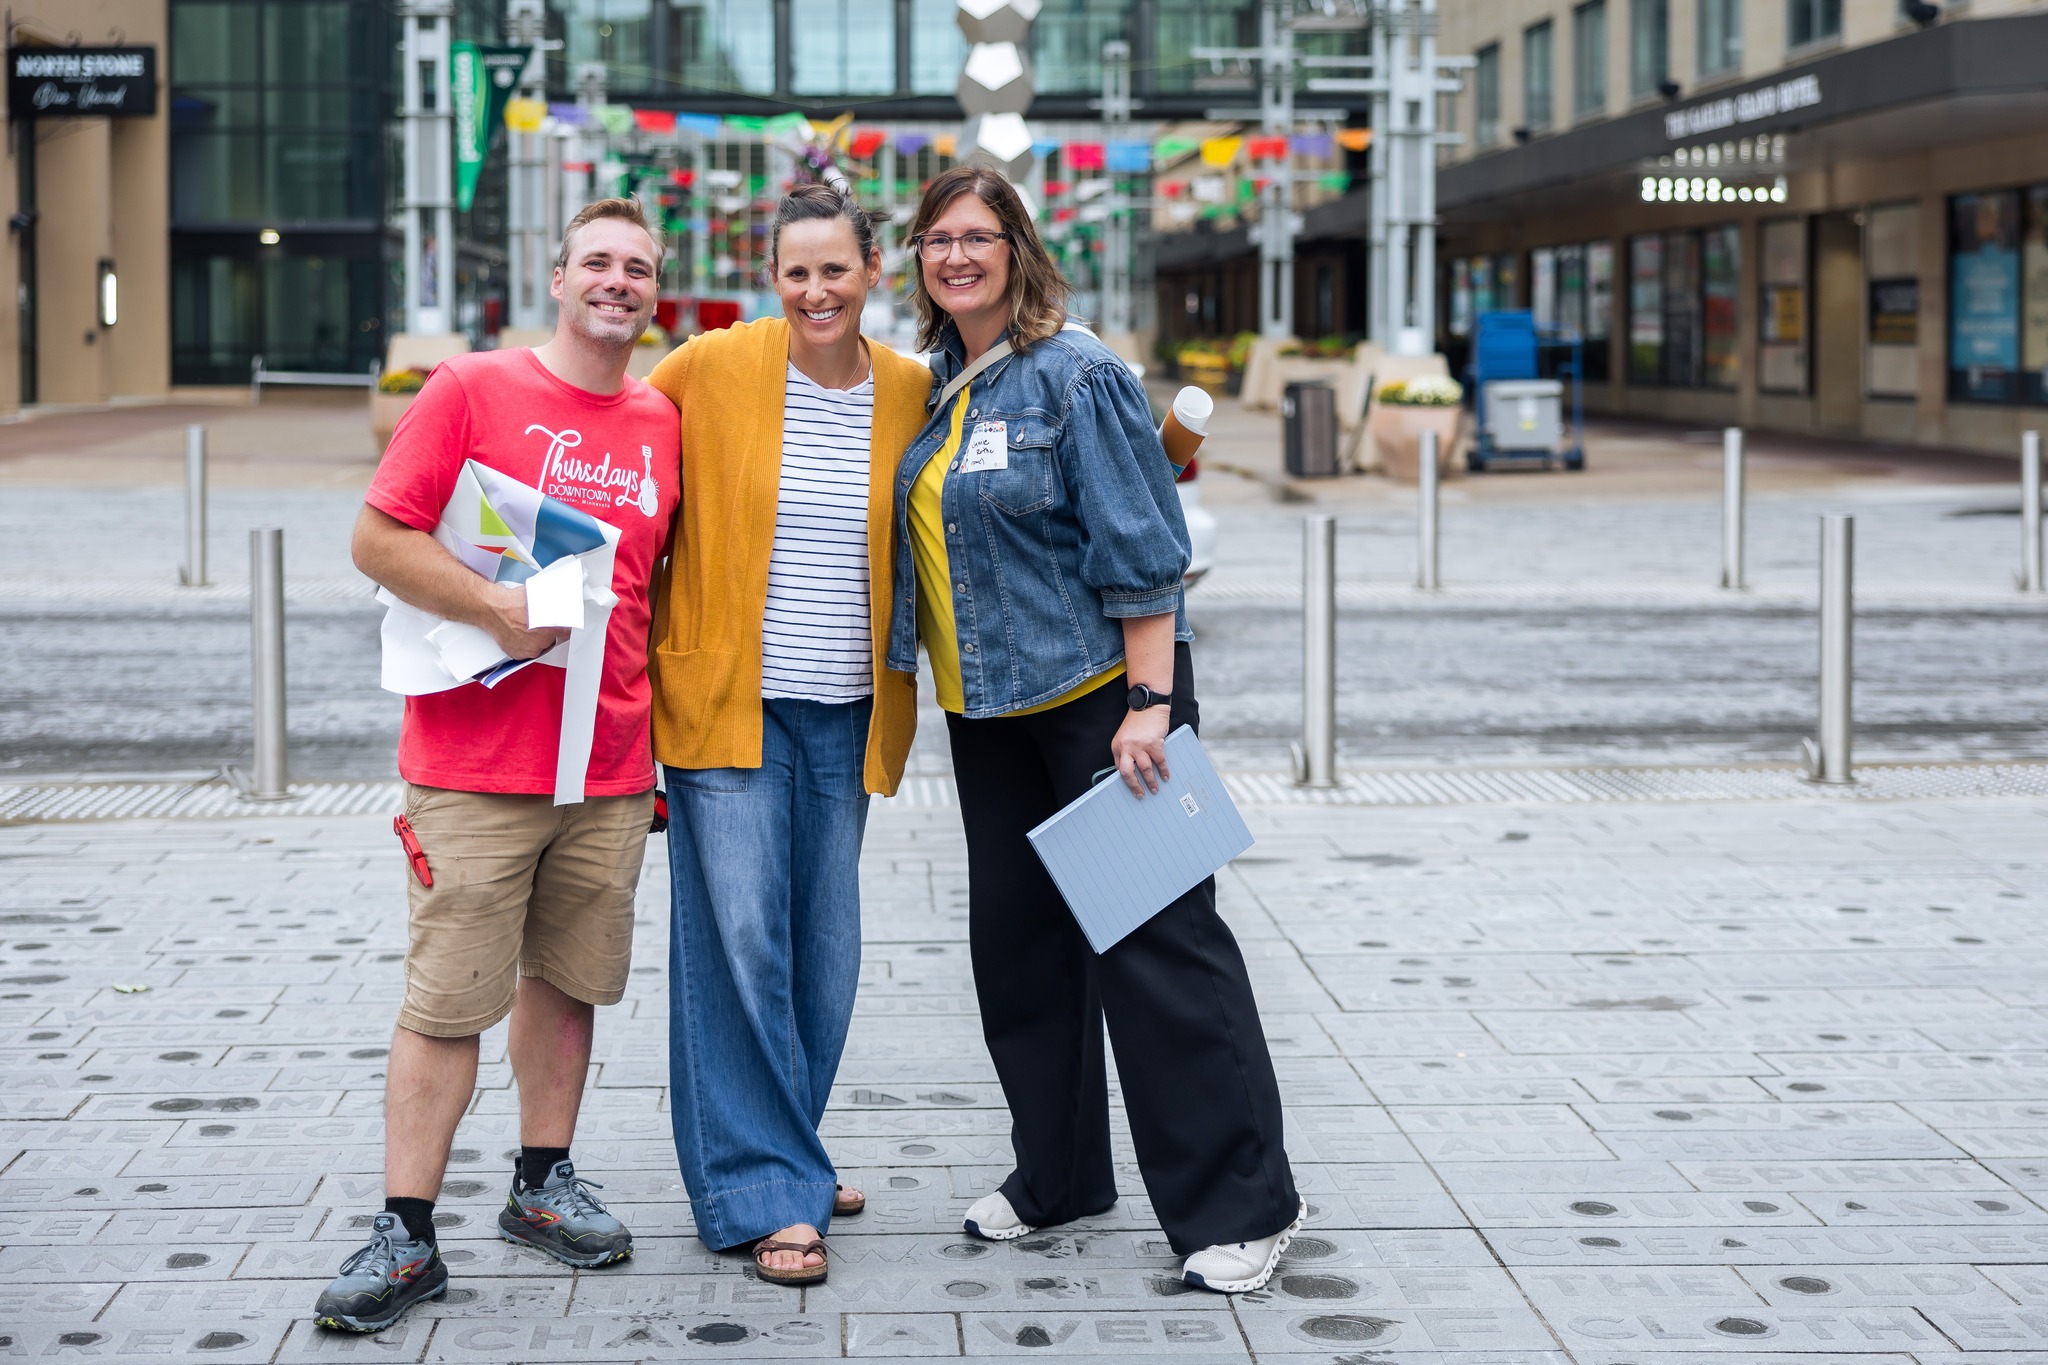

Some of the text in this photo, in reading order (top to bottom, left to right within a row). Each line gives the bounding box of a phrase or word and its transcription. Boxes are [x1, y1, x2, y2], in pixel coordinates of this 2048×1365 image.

[525, 424, 640, 507] Thursdays
[548, 483, 612, 503] DOWNTOWN
[98, 1027, 390, 1043] CULTUR
[1383, 1082, 1574, 1100] TIME
[2, 1126, 160, 1143] THE
[1404, 1109, 1567, 1126] THE
[21, 1154, 116, 1173] IN
[1438, 1136, 1595, 1155] ALL
[1615, 1134, 1942, 1154] THINGS
[0, 1179, 303, 1205] EARTH
[1702, 1165, 1972, 1185] SPIRIT
[125, 1212, 304, 1237] THE
[1472, 1197, 1793, 1220] LIQUID
[1835, 1196, 2026, 1219] AND
[0, 1249, 222, 1274] AND
[598, 1281, 784, 1306] THE
[1270, 1268, 1473, 1306] OF
[1529, 1273, 1736, 1298] THE
[1768, 1272, 1978, 1298] OLD
[453, 1320, 827, 1353] CHAOS
[866, 1322, 940, 1347] A
[978, 1318, 1227, 1348] WEB
[1285, 1309, 1503, 1349] OF
[1566, 1313, 1929, 1342] CLOTH
